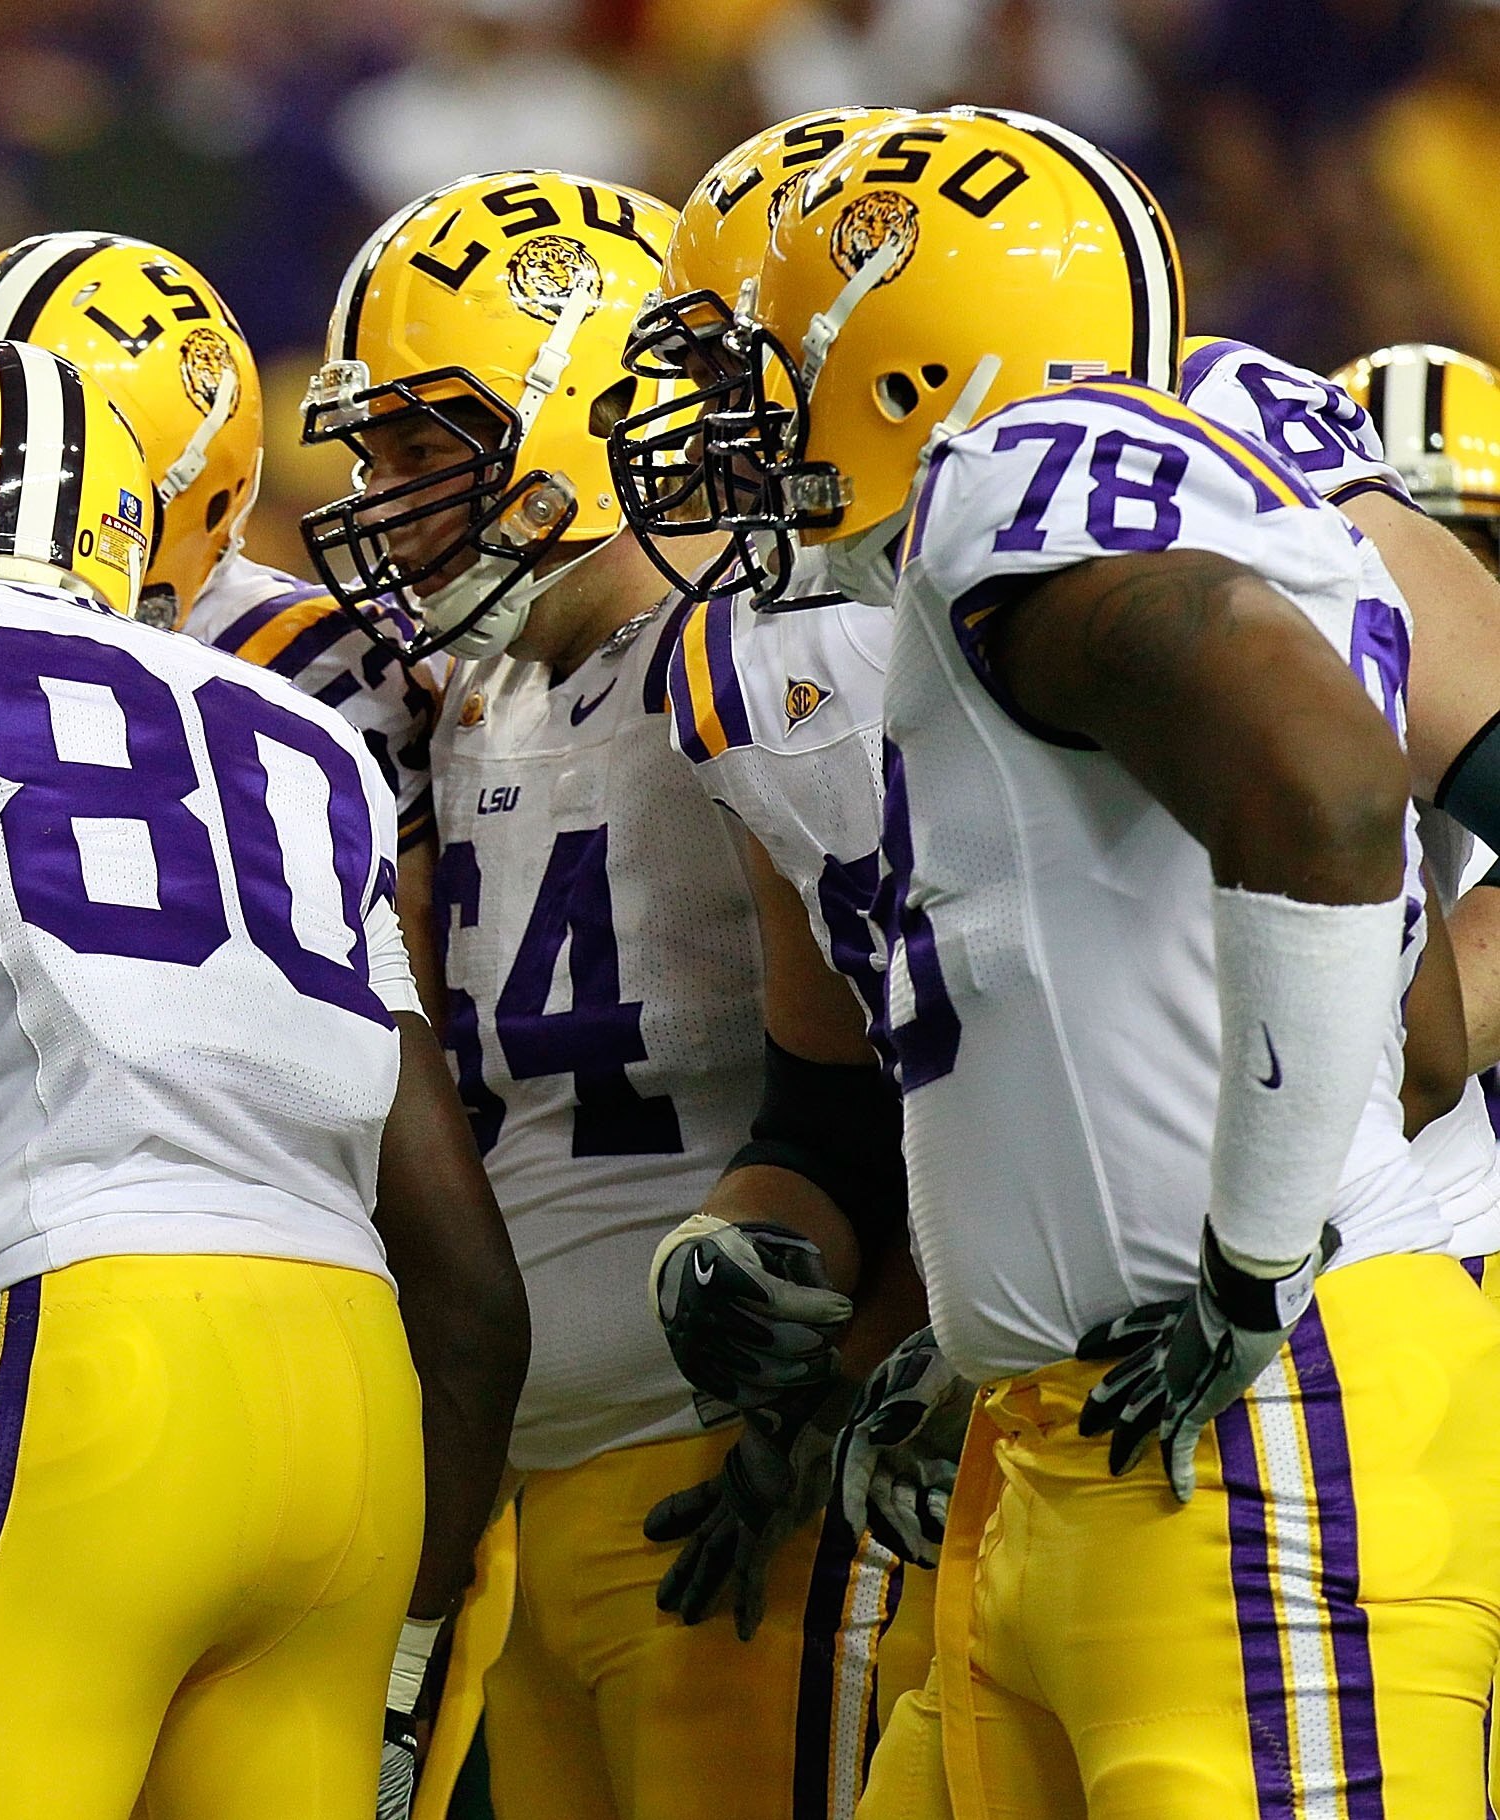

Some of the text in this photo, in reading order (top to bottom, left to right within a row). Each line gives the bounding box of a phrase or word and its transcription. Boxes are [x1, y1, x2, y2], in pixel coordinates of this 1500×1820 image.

[408, 182, 638, 292] LSU
[990, 421, 1190, 554] 78
[77, 528, 94, 558] 0
[113, 520, 147, 547] DANGER
[791, 684, 811, 716] SEC
[477, 786, 521, 815] LSU
